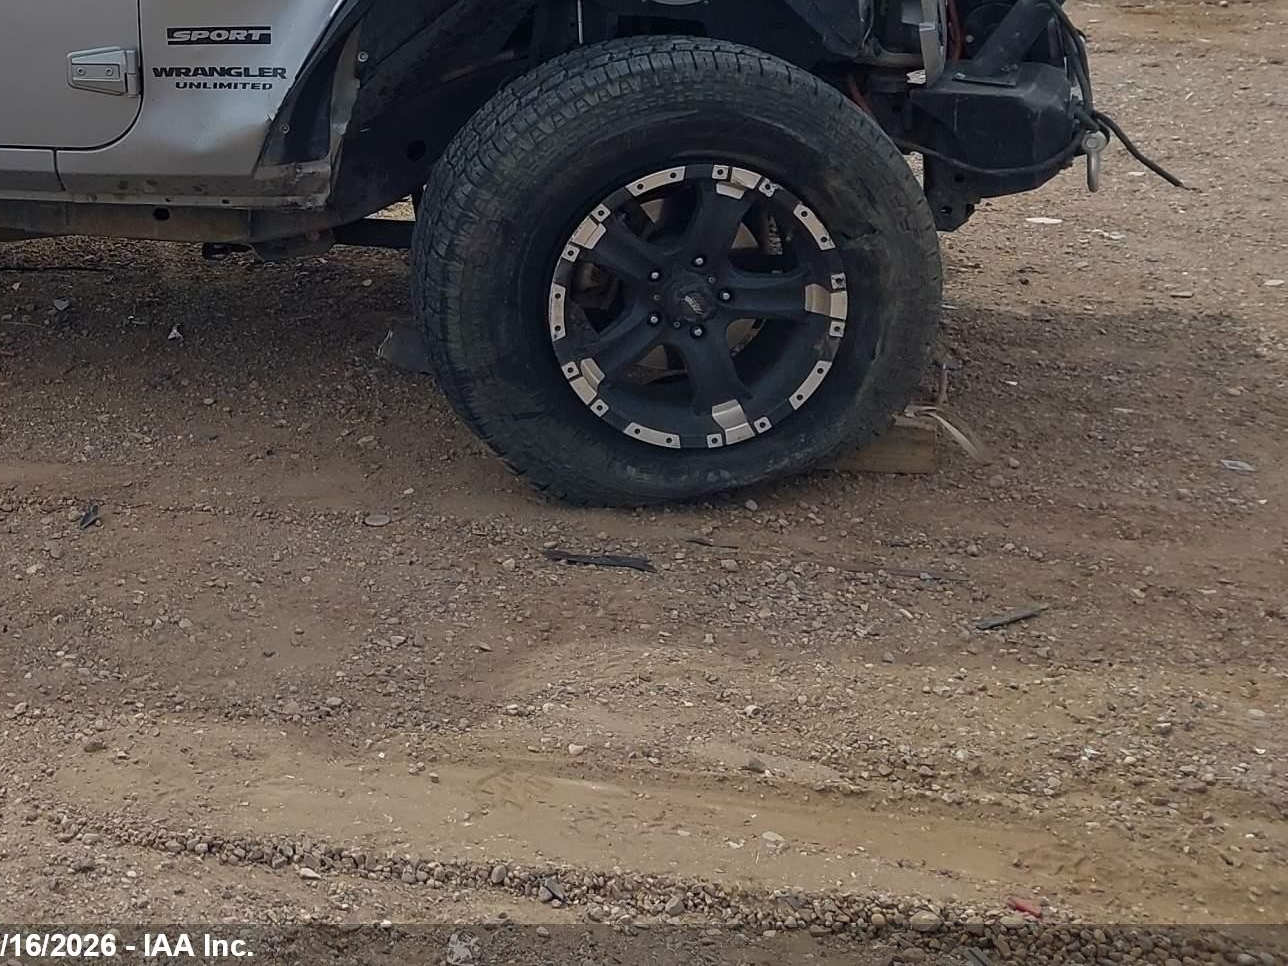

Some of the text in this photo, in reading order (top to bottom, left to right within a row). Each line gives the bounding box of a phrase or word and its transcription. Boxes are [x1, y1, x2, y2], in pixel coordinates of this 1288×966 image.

[168, 29, 271, 42] SPORT
[152, 67, 287, 79] WRANGLER
[176, 81, 273, 91] UNLIMITED
